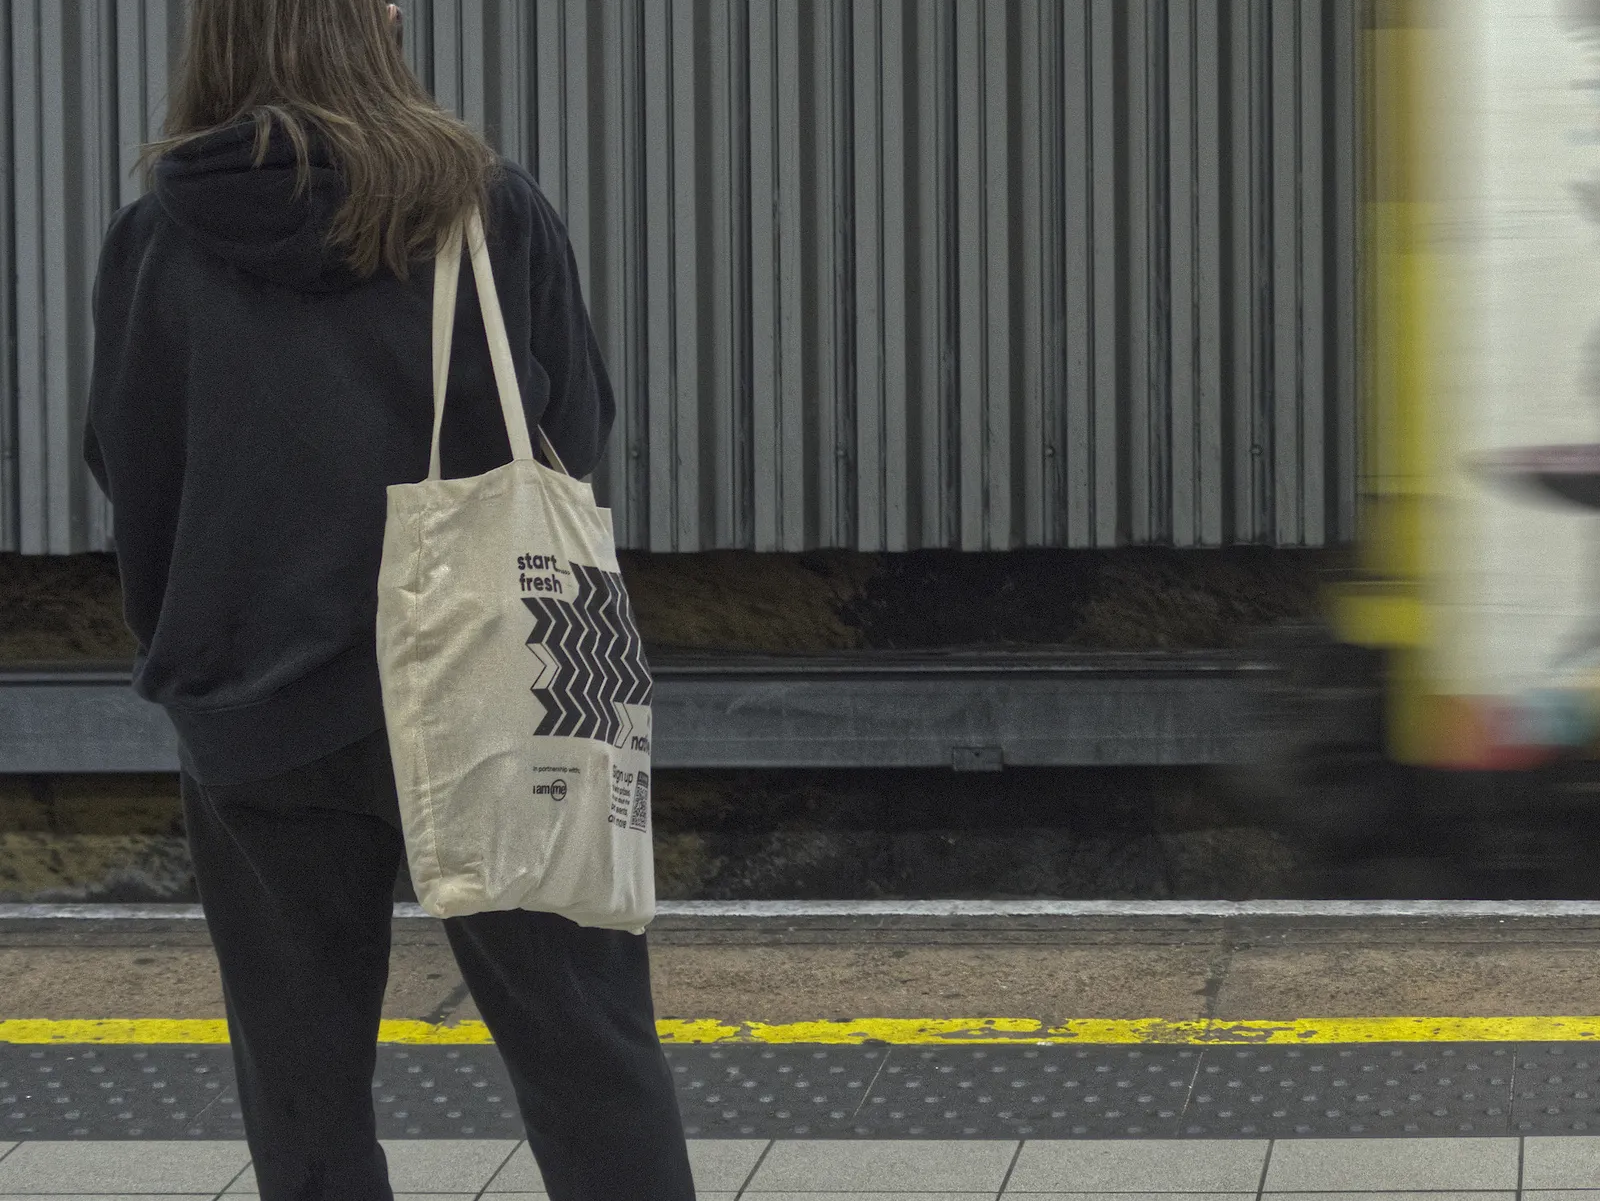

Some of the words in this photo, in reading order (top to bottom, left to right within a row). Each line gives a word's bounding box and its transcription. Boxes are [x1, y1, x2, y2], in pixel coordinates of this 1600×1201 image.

[517, 552, 560, 573] start
[519, 573, 563, 594] fresh
[624, 772, 634, 787] up
